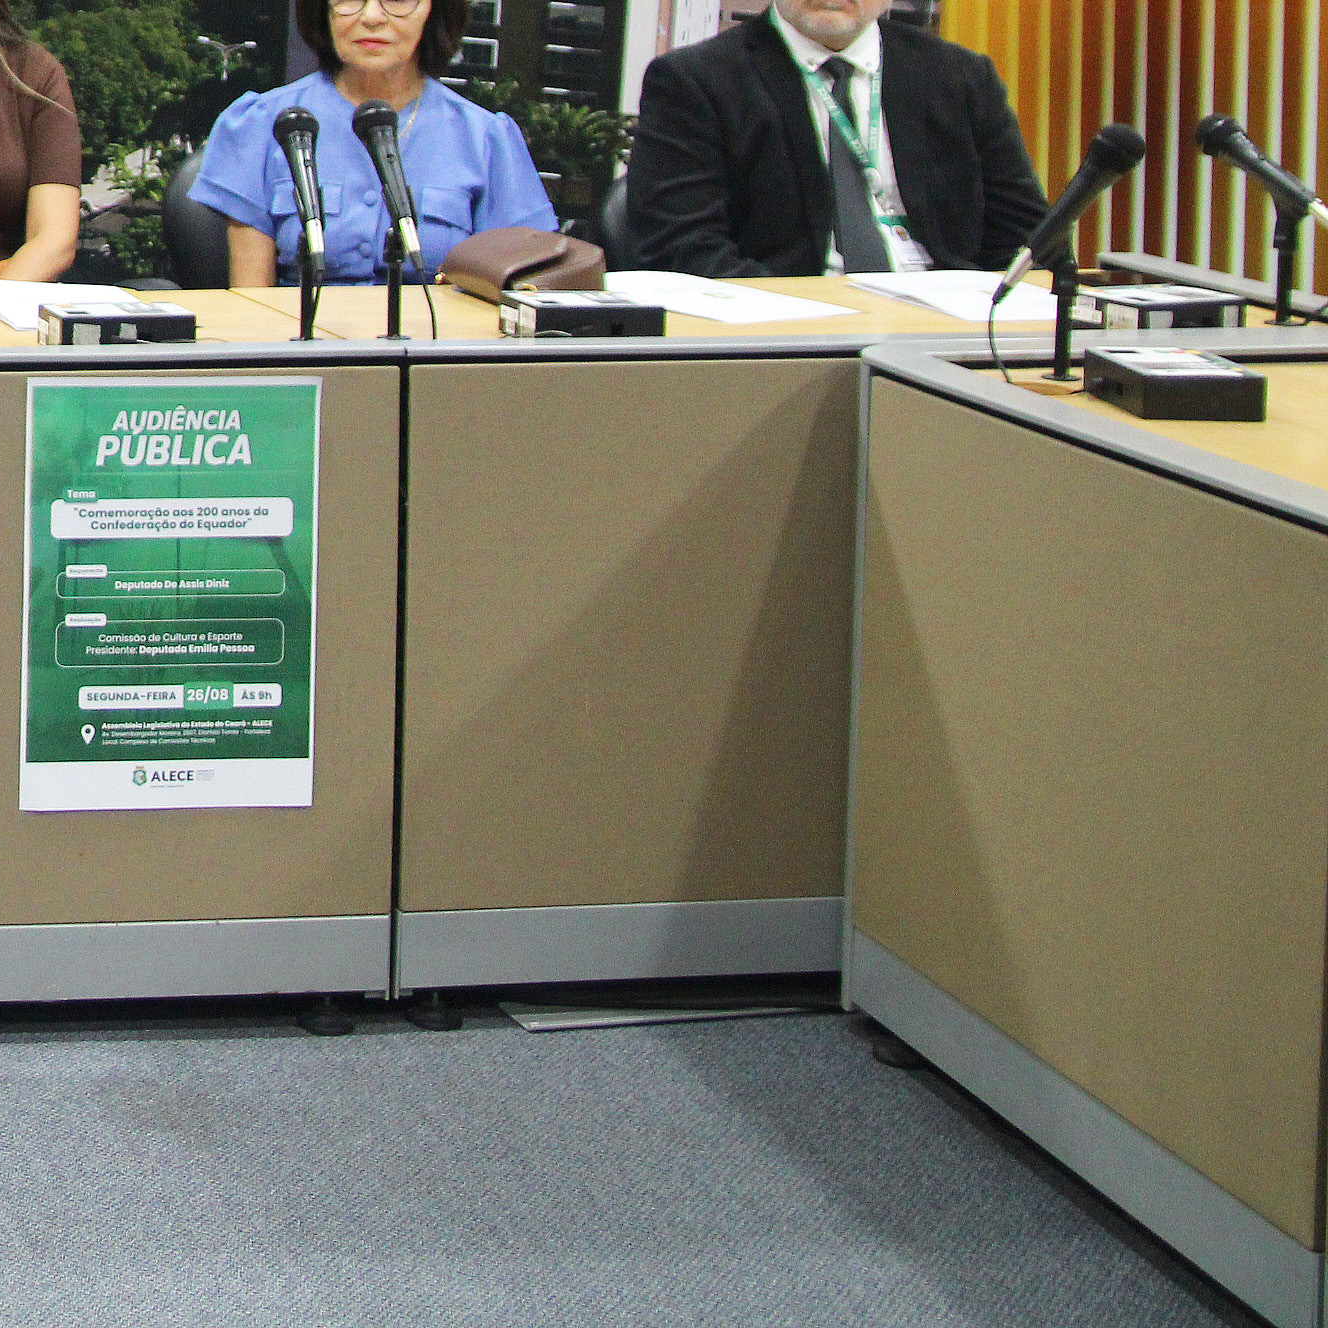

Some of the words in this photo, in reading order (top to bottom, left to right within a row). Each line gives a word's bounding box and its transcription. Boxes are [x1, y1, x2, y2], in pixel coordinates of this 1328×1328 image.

[112, 405, 242, 433] AUDIÊNCIA
[67, 490, 97, 499] Tema
[74, 507, 170, 520] "Comemoração
[173, 508, 194, 517] aos
[196, 507, 219, 517] 200
[221, 508, 250, 517] anos
[253, 506, 269, 516] da
[90, 520, 177, 533] Confederação
[179, 519, 195, 529] do
[197, 518, 253, 532] Equador"
[115, 580, 163, 591] Deputado
[164, 580, 178, 589] De
[179, 579, 205, 589] Assis
[206, 578, 230, 588] Diniz
[98, 633, 147, 643] Comissão
[148, 633, 161, 642] de
[162, 633, 198, 642] Cultura
[207, 632, 243, 643] Esporte
[86, 645, 138, 655] Presidente:
[139, 645, 187, 656] Deputada
[220, 644, 255, 653] Pessoa
[87, 691, 177, 701] SEGUNDA-FEIRA
[187, 686, 230, 703] 26/08
[258, 690, 272, 700] 9h
[150, 770, 195, 782] ALECE
